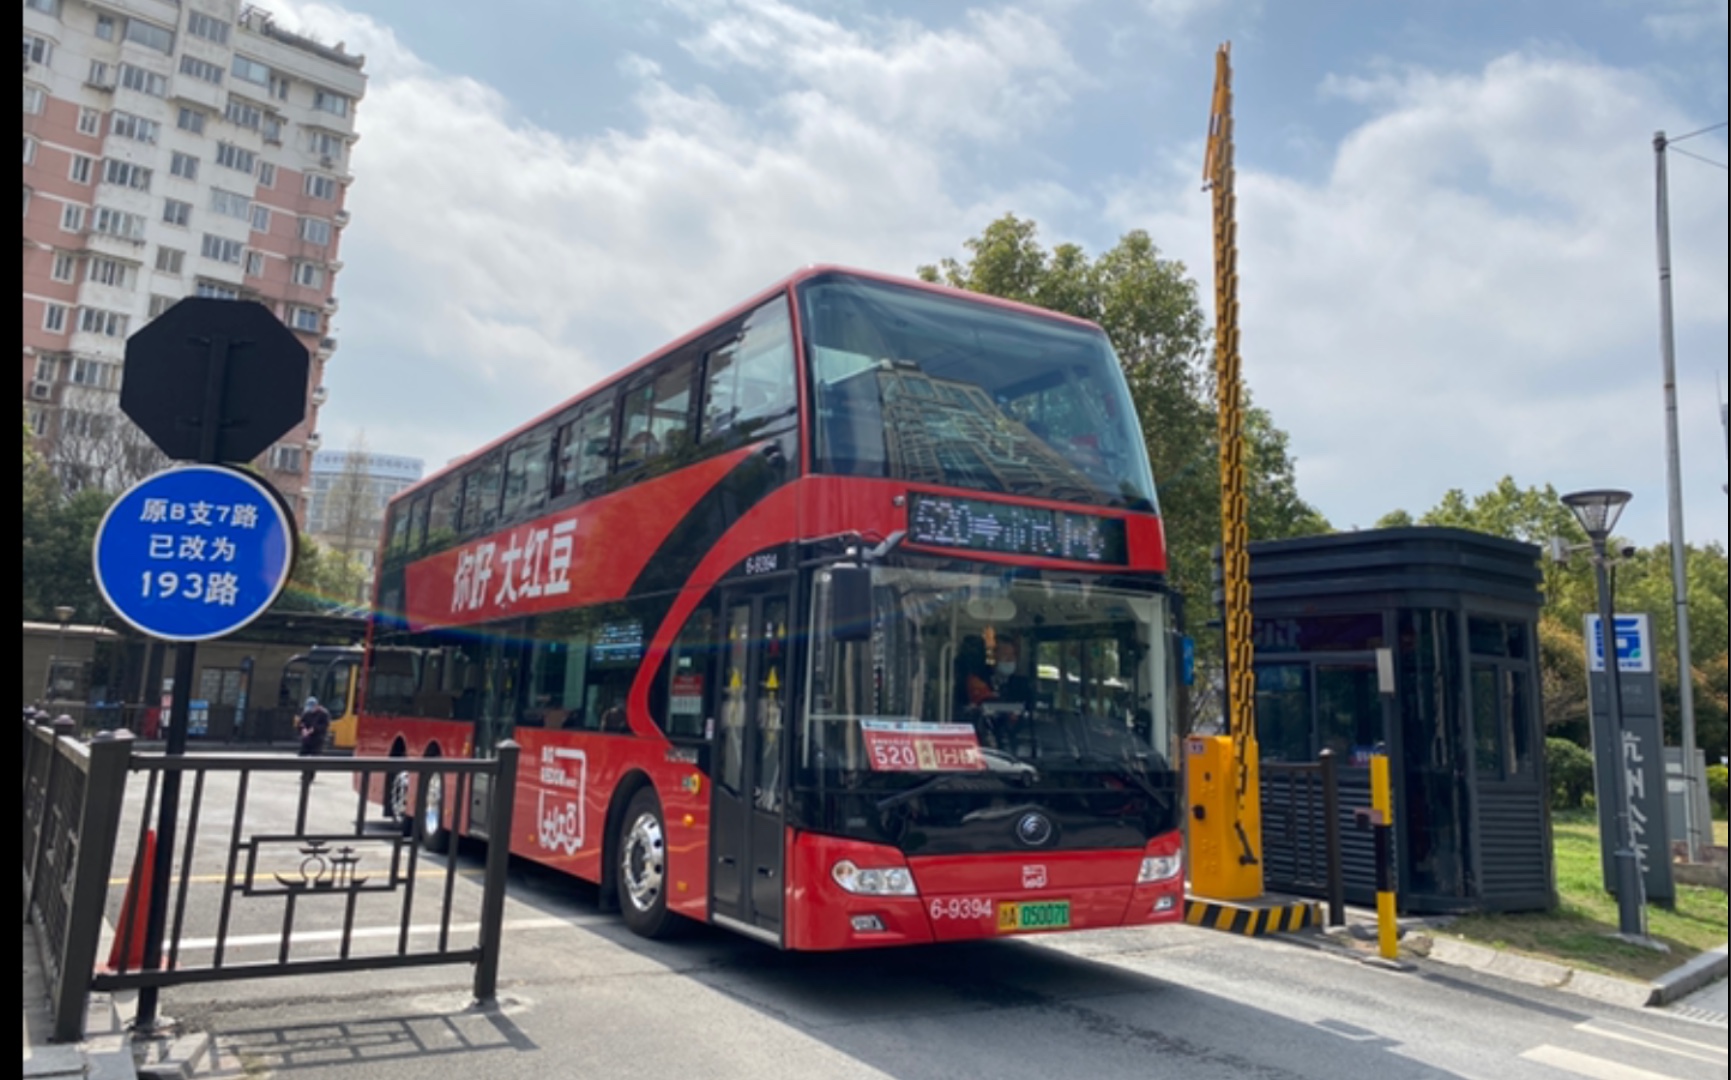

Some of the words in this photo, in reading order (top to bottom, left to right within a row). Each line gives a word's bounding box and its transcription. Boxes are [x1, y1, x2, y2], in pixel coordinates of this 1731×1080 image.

[139, 498, 259, 529] 原B支7路
[916, 499, 973, 544] 520
[148, 533, 236, 562] 已改为
[451, 541, 496, 613] 你好
[495, 518, 578, 604] 大红豆
[141, 571, 240, 606] 193路
[874, 745, 916, 765] 520
[930, 897, 992, 920] 6-9394
